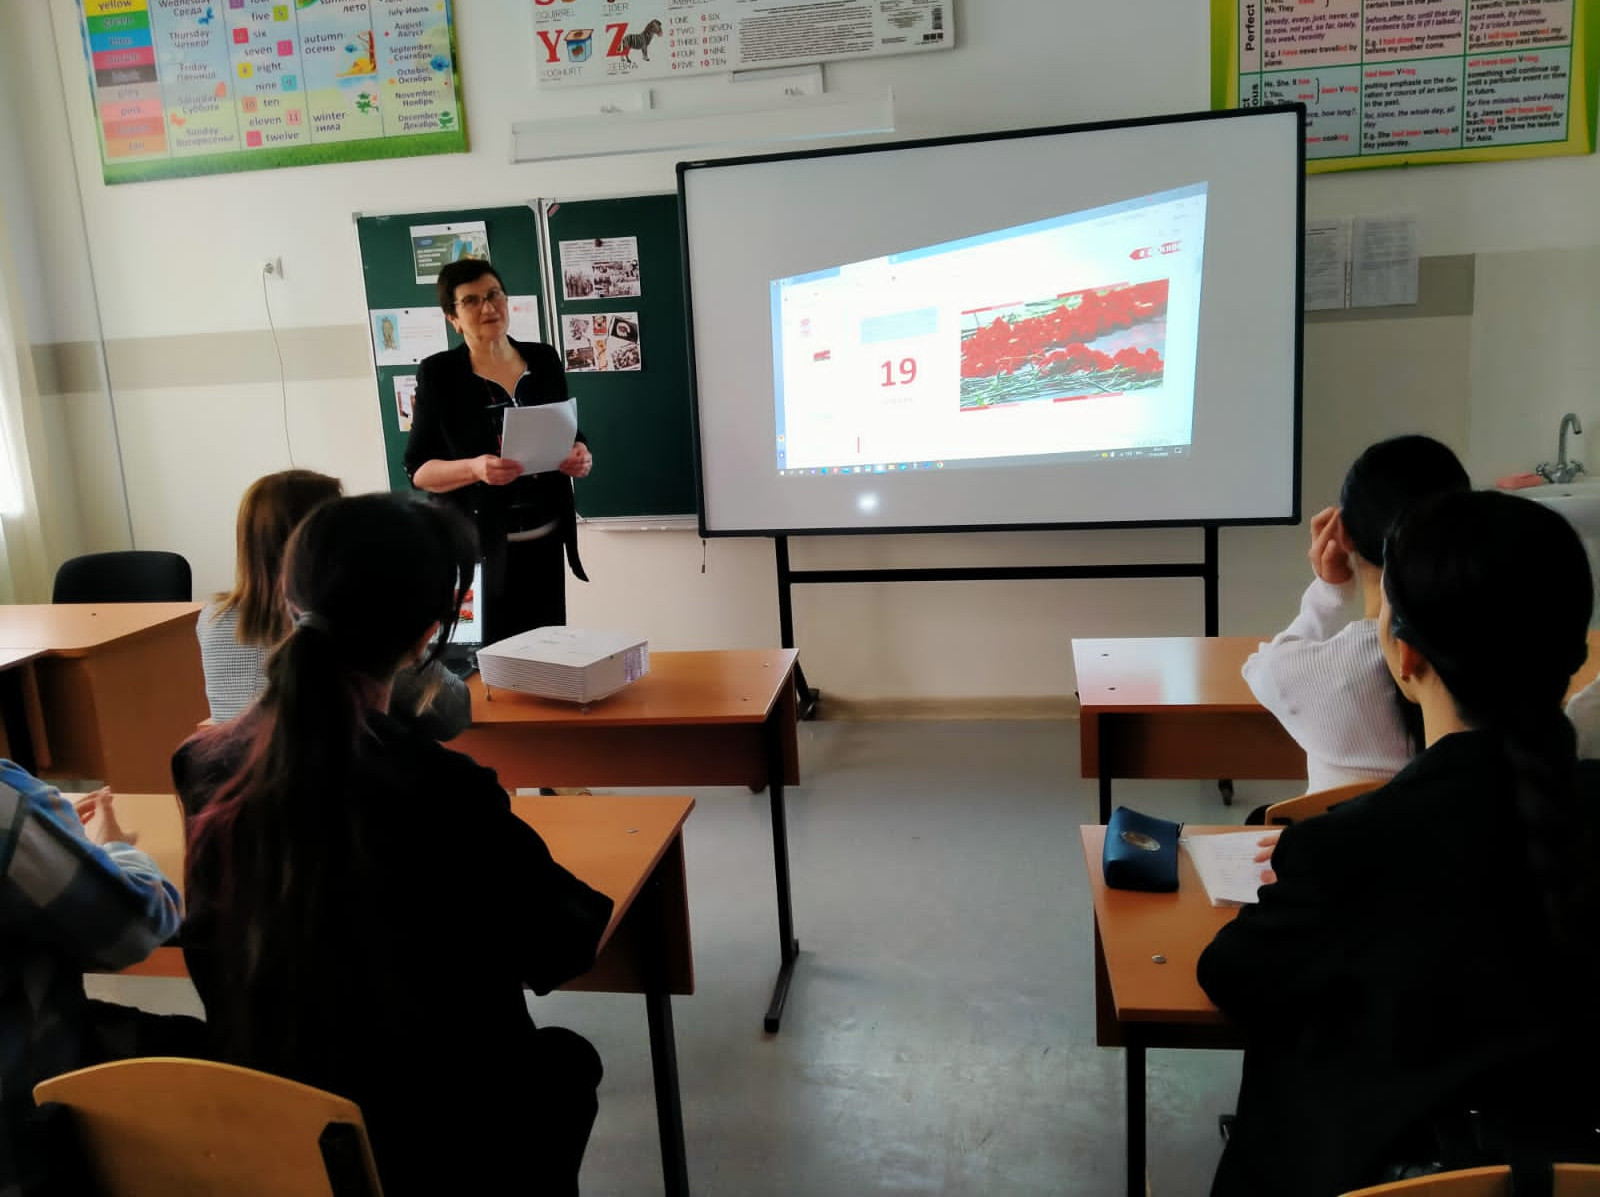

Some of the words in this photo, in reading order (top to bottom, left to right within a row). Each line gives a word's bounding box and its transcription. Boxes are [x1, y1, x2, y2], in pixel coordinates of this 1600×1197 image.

[173, 7, 202, 16] Среда
[343, 4, 366, 12] лето
[1280, 5, 1294, 13] They
[252, 12, 270, 21] five
[1245, 4, 1255, 51] Perfect
[253, 29, 267, 37] six
[606, 22, 630, 57] Z
[245, 46, 272, 55] seven
[305, 46, 336, 54] осень
[536, 29, 564, 63] Y
[257, 62, 281, 73] eight
[256, 82, 277, 91] nine
[264, 99, 280, 107] ten
[249, 117, 281, 126] eleven
[266, 132, 300, 141] twelve
[881, 358, 917, 387] 19
